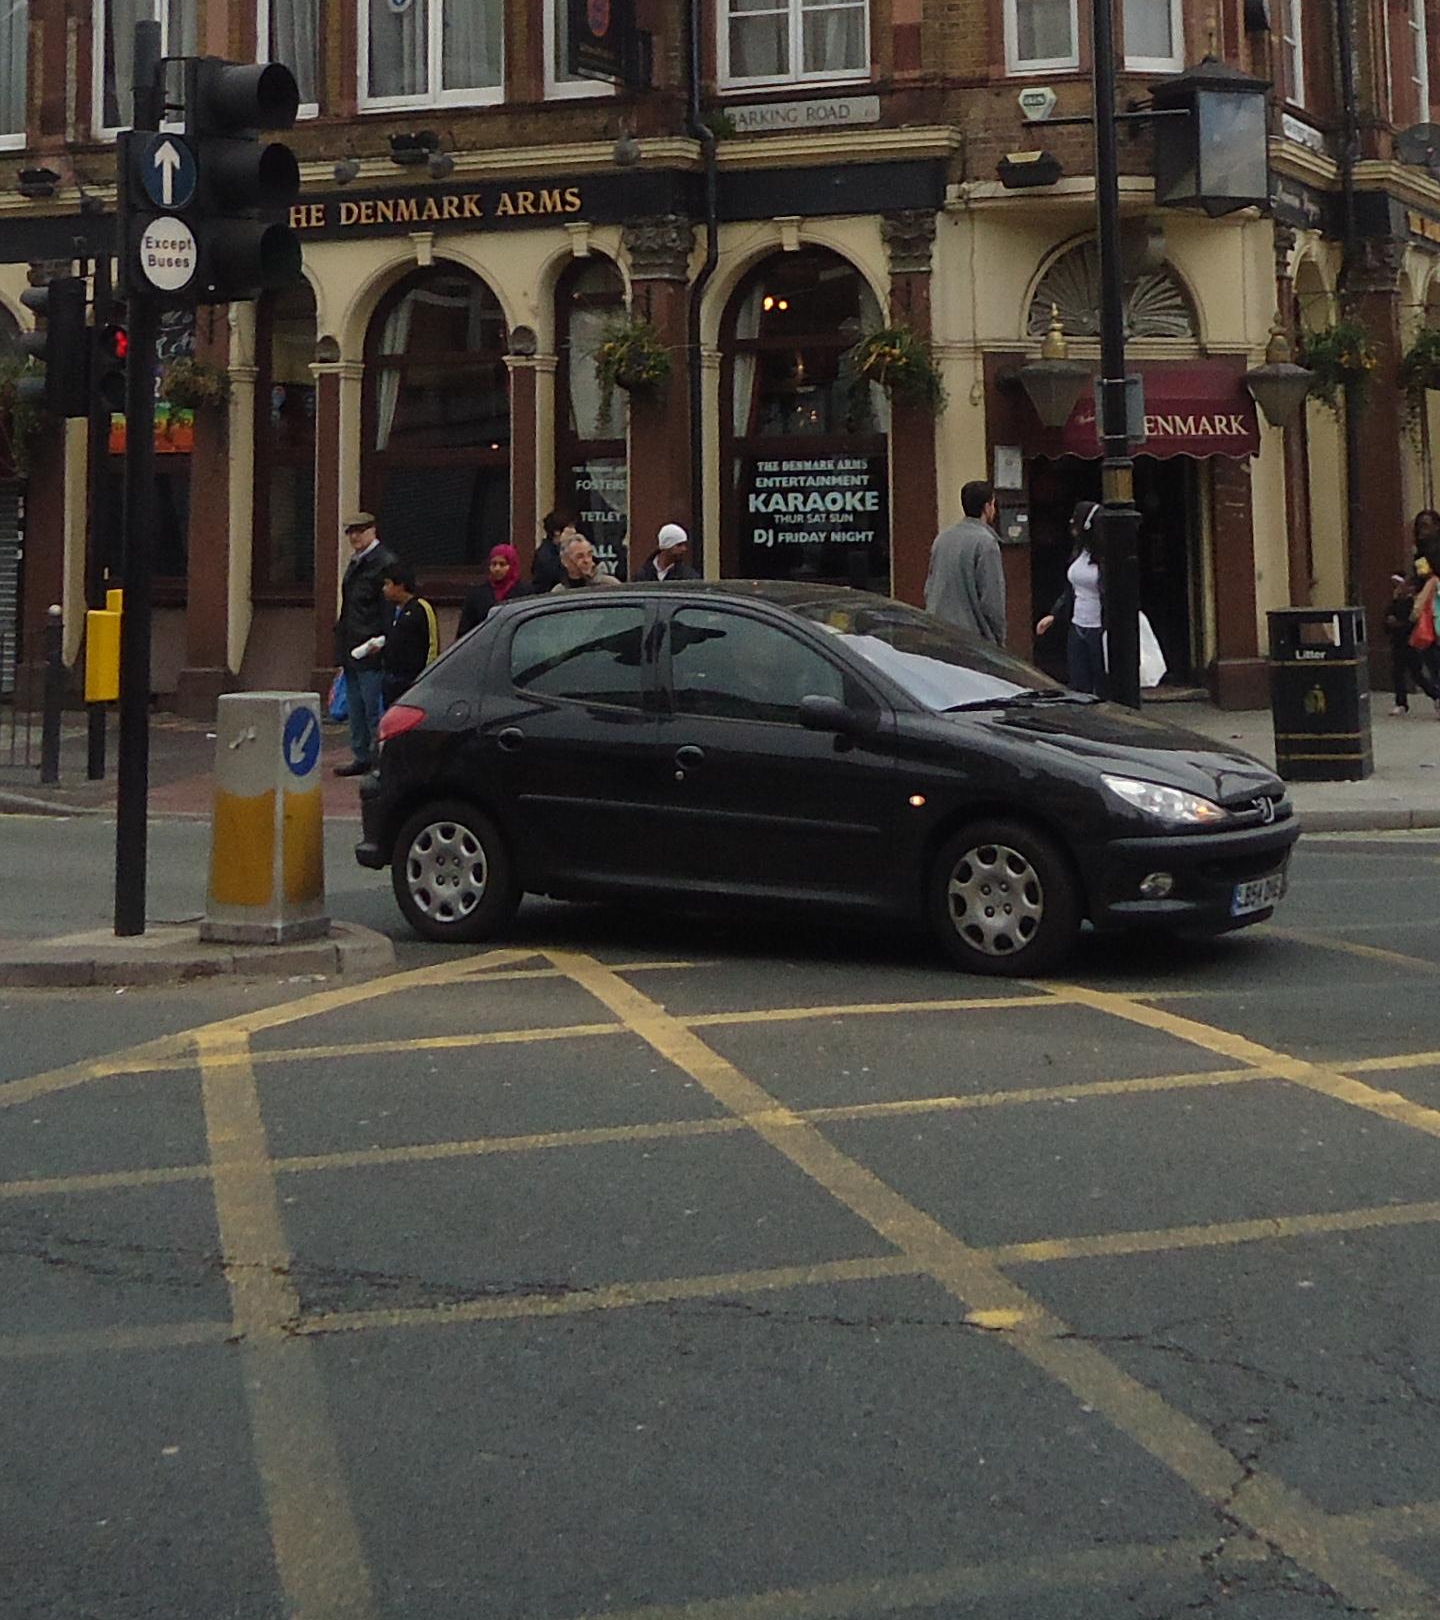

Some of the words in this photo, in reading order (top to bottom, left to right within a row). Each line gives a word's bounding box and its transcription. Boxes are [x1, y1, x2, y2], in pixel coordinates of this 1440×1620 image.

[728, 108, 798, 127] BARKING
[806, 104, 851, 121] ROAD
[288, 203, 326, 229] HE
[339, 194, 484, 226] DENMARK
[495, 187, 583, 216] ARMS
[145, 235, 192, 253] Except
[148, 254, 190, 268] Buses
[1143, 414, 1249, 436] ENMARK
[755, 475, 870, 488] ENTERTAINMENT
[748, 491, 880, 513] KARAOKE
[580, 511, 621, 522] TETLEY
[773, 514, 804, 524] THUR
[807, 513, 827, 524] SAT
[829, 513, 854, 523] SUN
[753, 529, 774, 548] DJ
[777, 531, 827, 543] FRIDAY
[830, 531, 875, 543] NIGHT
[1295, 649, 1327, 660] Litter
